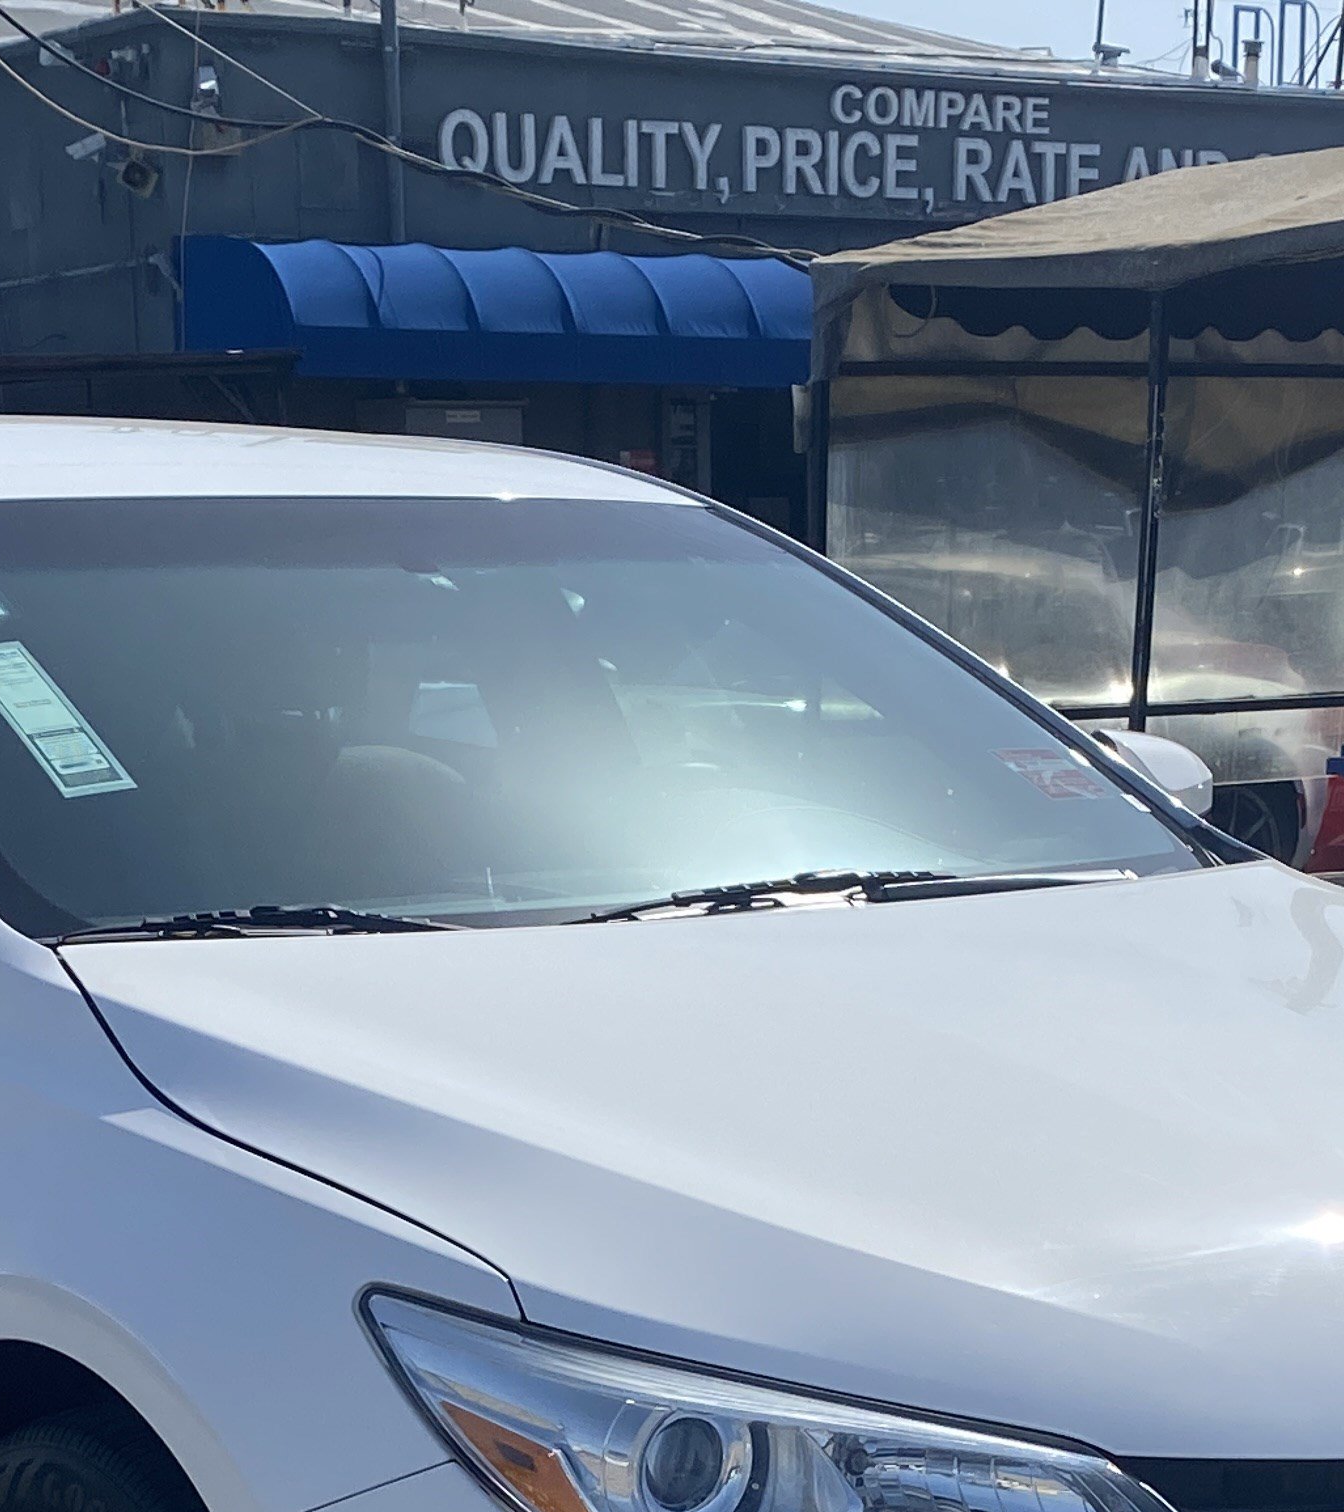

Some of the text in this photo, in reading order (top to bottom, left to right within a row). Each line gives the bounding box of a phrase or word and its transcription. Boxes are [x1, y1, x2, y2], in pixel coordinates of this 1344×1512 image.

[831, 83, 1052, 135] COMPARE
[437, 107, 731, 204] QUALITY,
[742, 124, 936, 214] PRICE,
[955, 136, 1102, 203] RATE
